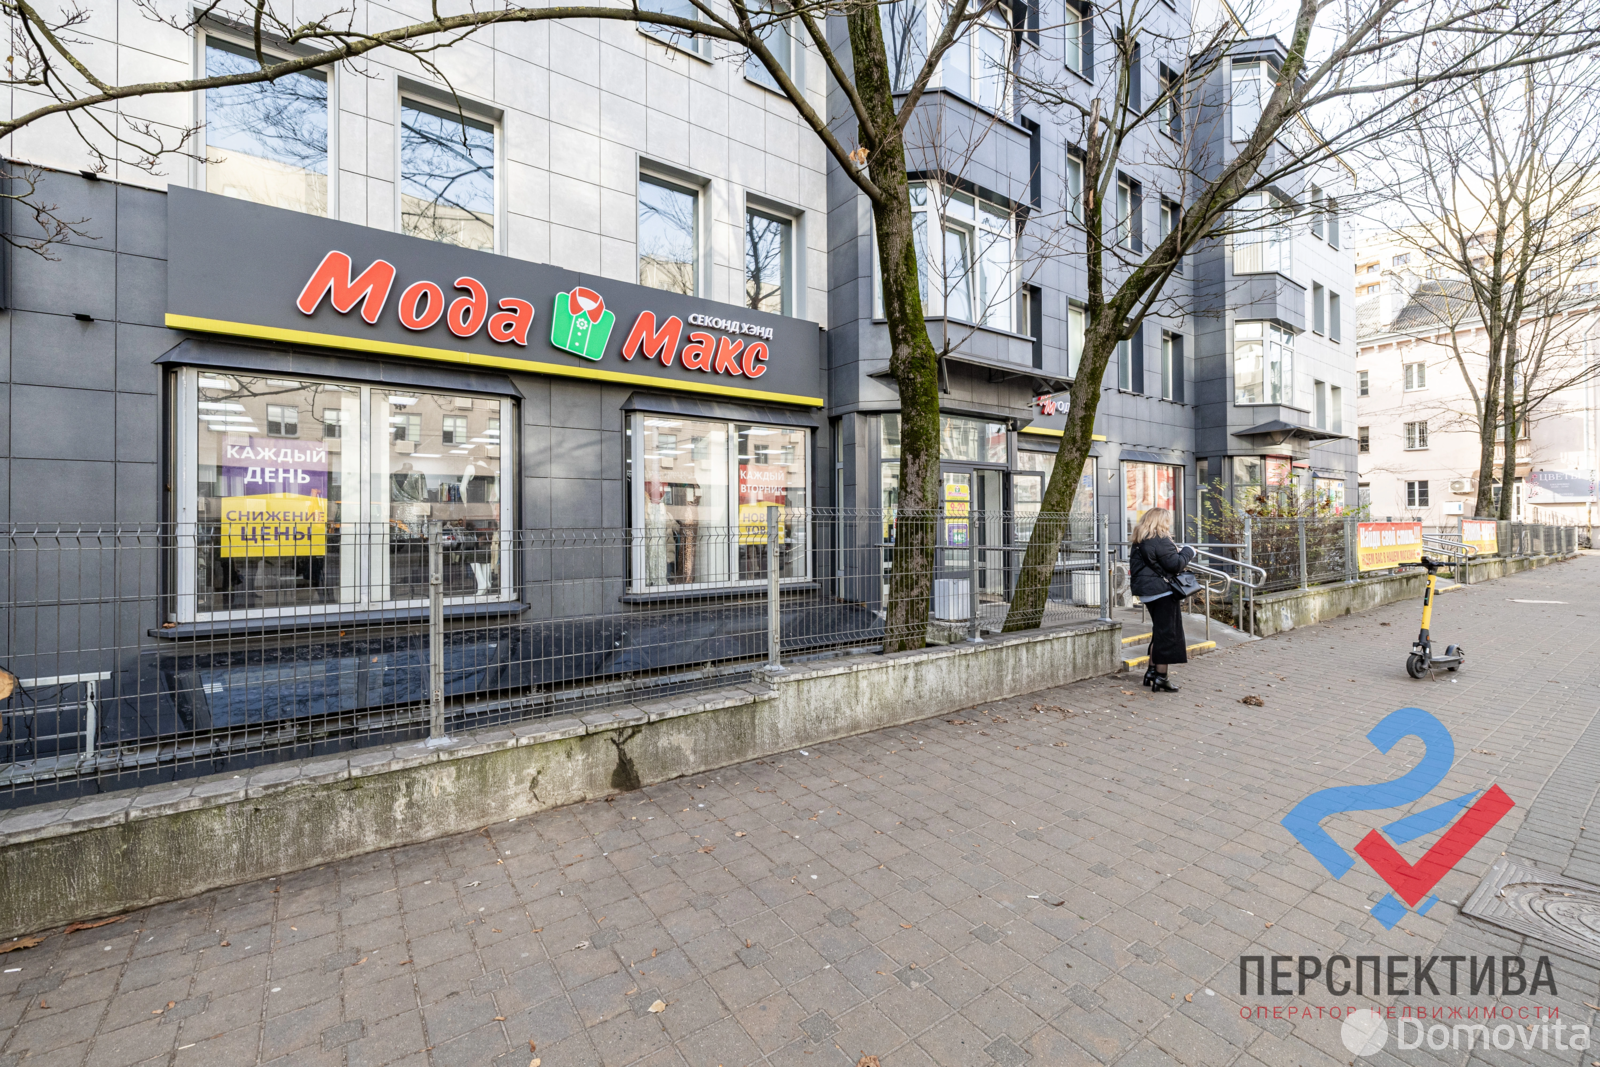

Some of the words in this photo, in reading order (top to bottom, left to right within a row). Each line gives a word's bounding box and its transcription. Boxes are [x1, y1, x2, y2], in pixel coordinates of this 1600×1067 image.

[296, 250, 535, 347] Мода
[621, 310, 769, 379] Макс
[688, 313, 740, 334] СЕКОНД
[740, 322, 774, 341] ХЭНД
[226, 445, 326, 464] КАЖДЫЙ
[243, 466, 311, 485] ДЕНЬ
[740, 470, 785, 482] КАЖДЫЙ
[1539, 473, 1582, 482] ЦВЕТЫ
[740, 483, 784, 494] ВТОРНИК
[226, 510, 325, 522] СНИЖЕНИЕ
[241, 526, 313, 544] ЦЕНЫ
